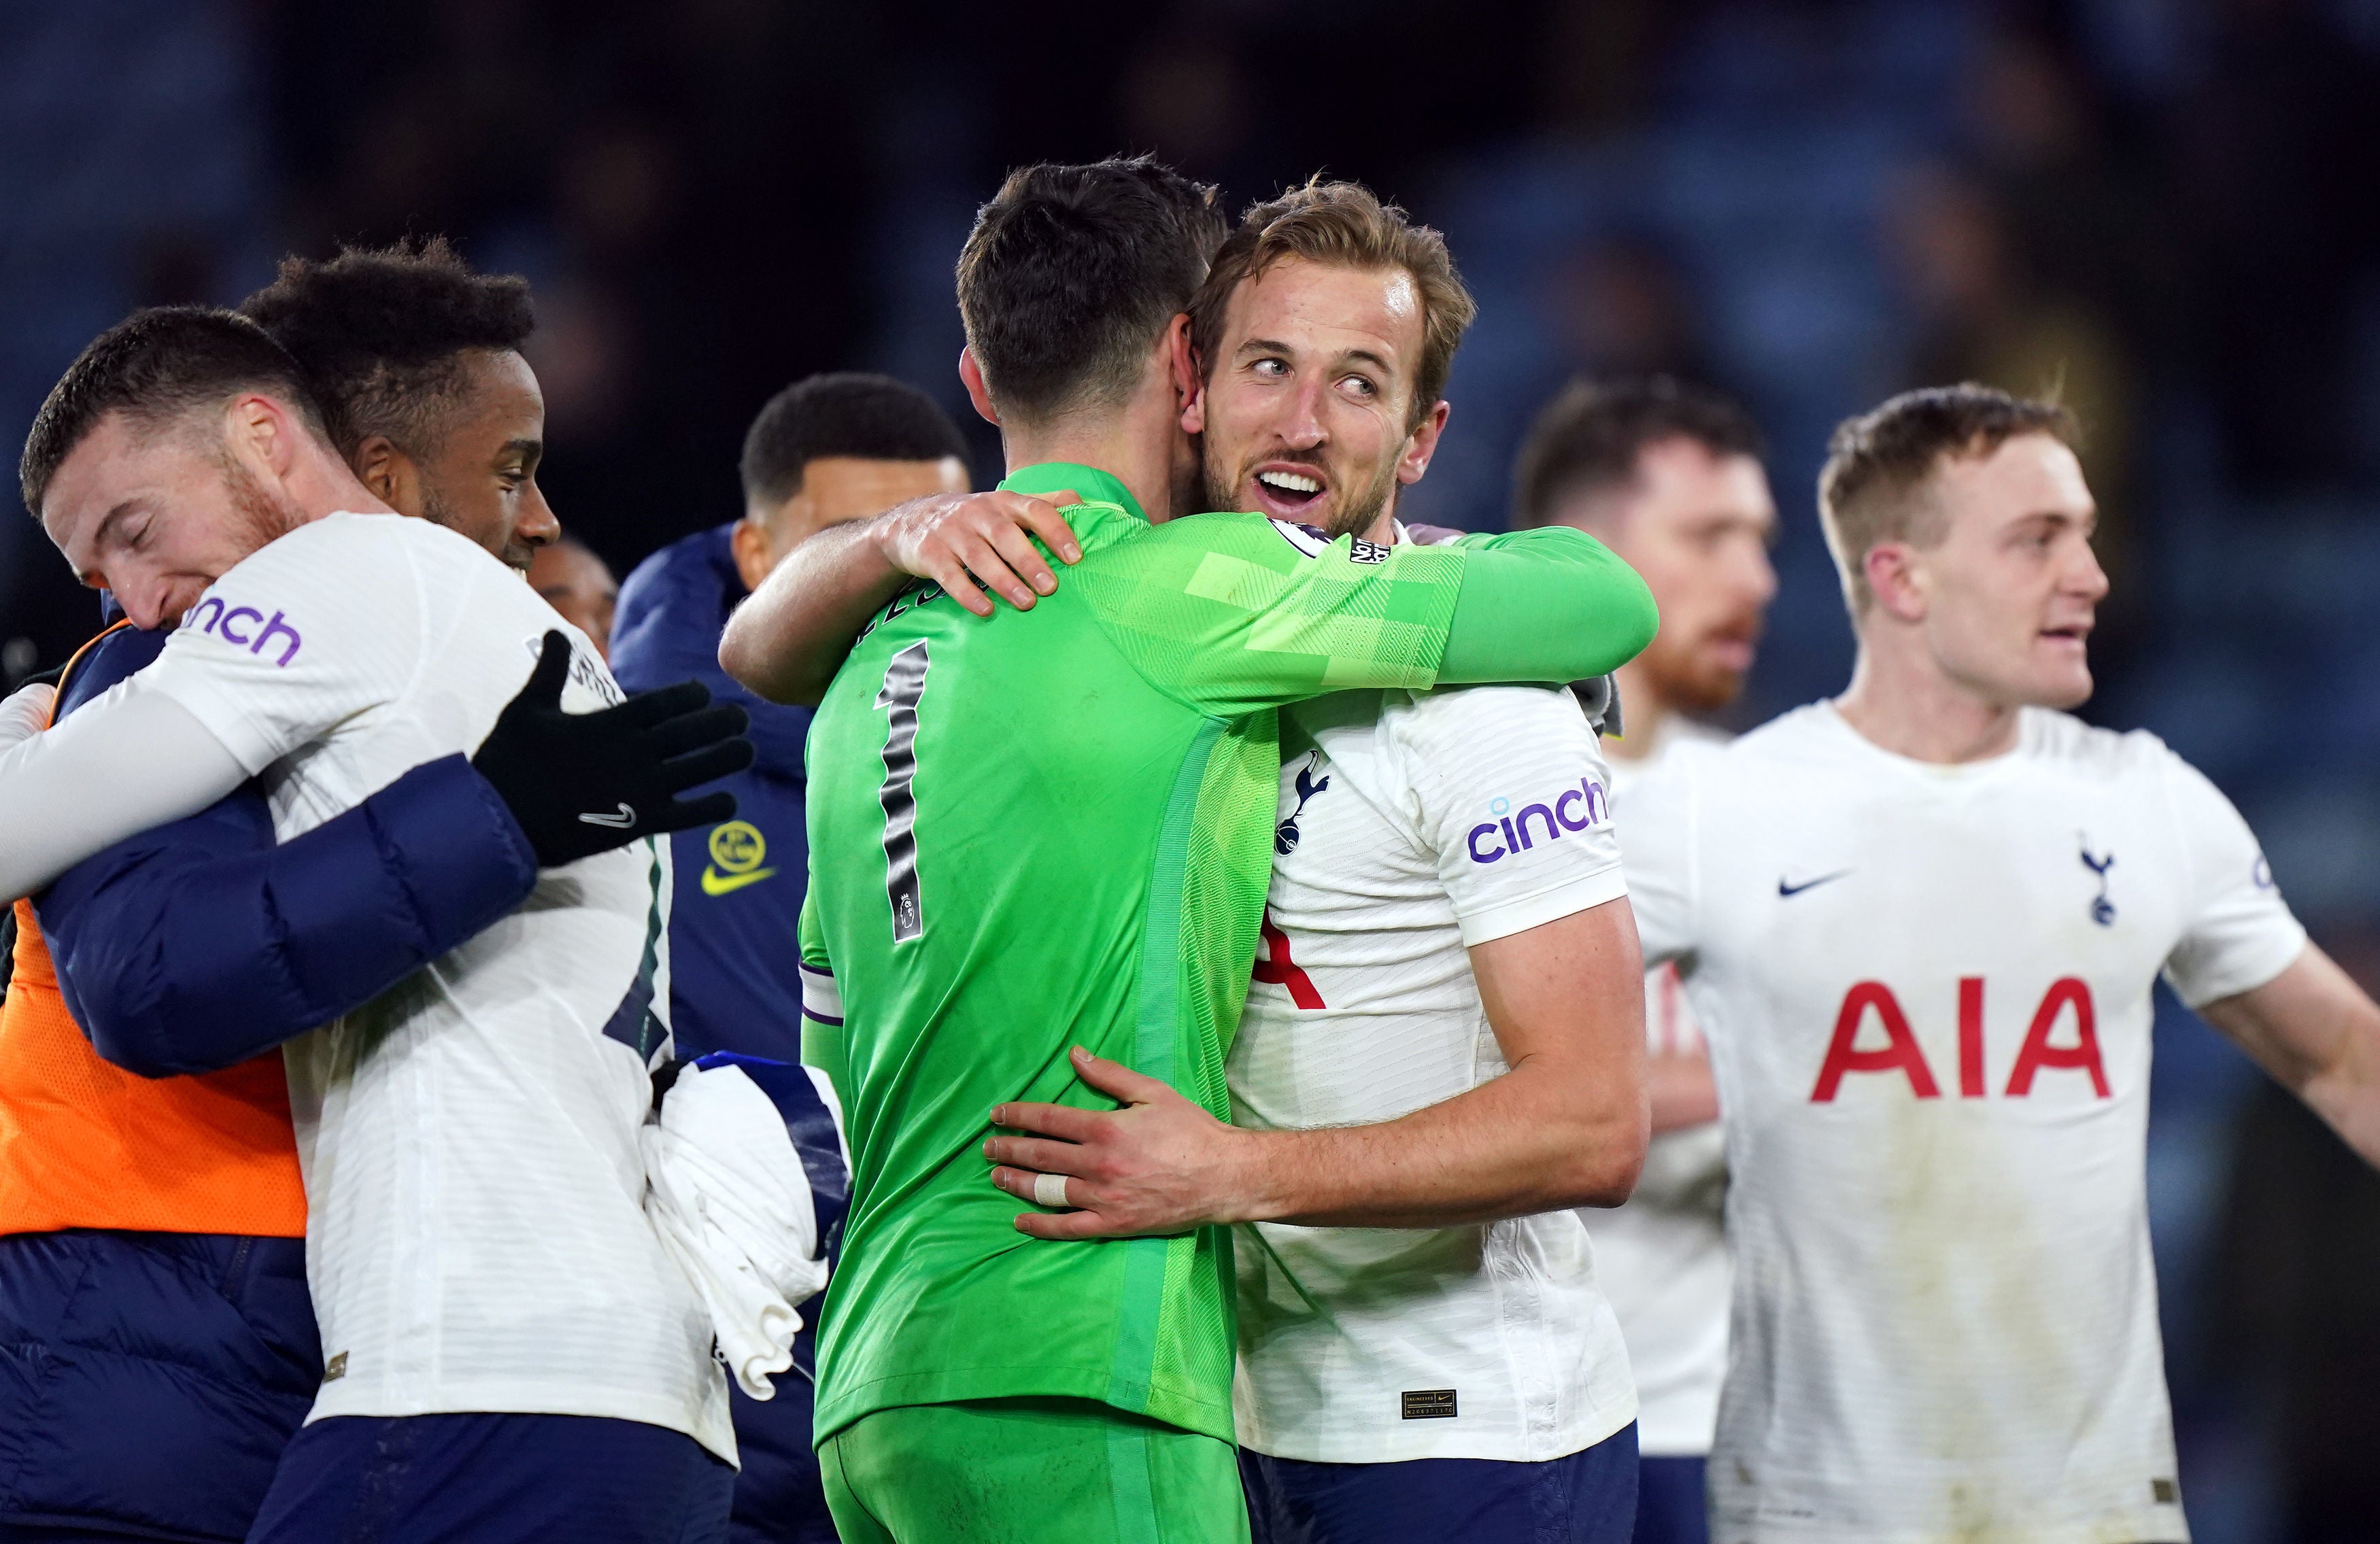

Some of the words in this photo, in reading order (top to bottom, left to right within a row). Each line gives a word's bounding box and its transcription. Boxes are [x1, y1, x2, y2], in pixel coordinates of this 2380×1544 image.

[873, 638, 930, 944] 1
[1468, 777, 1608, 863] cinch
[1809, 976, 2112, 1103] AIA
